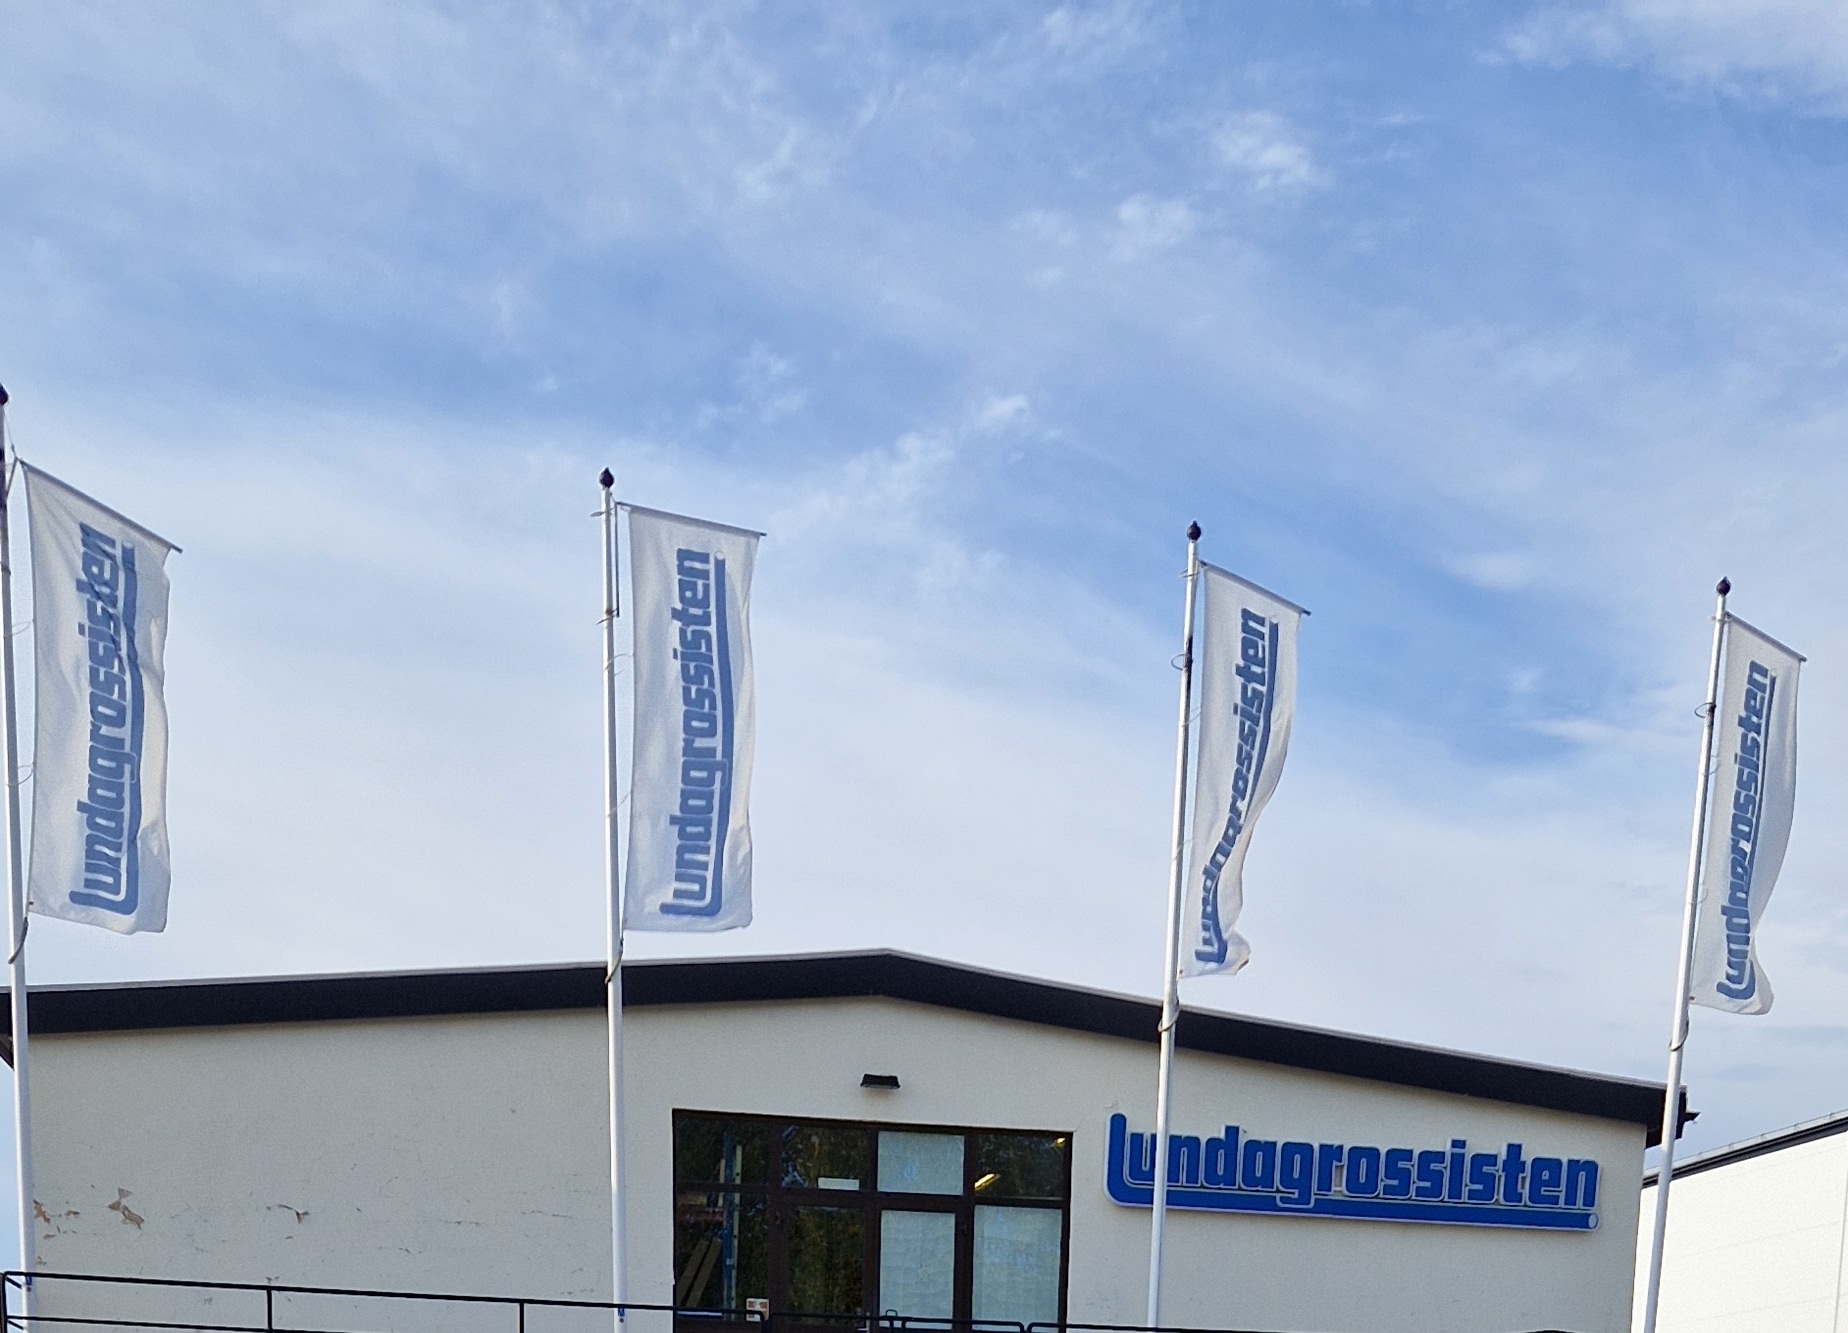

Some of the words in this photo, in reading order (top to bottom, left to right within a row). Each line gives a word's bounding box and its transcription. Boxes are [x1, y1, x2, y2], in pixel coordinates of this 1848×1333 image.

[70, 521, 143, 916] Lundagrossisten
[659, 547, 735, 917] Lundagrossisten
[1106, 1112, 1600, 1231] Lundagrossisten
